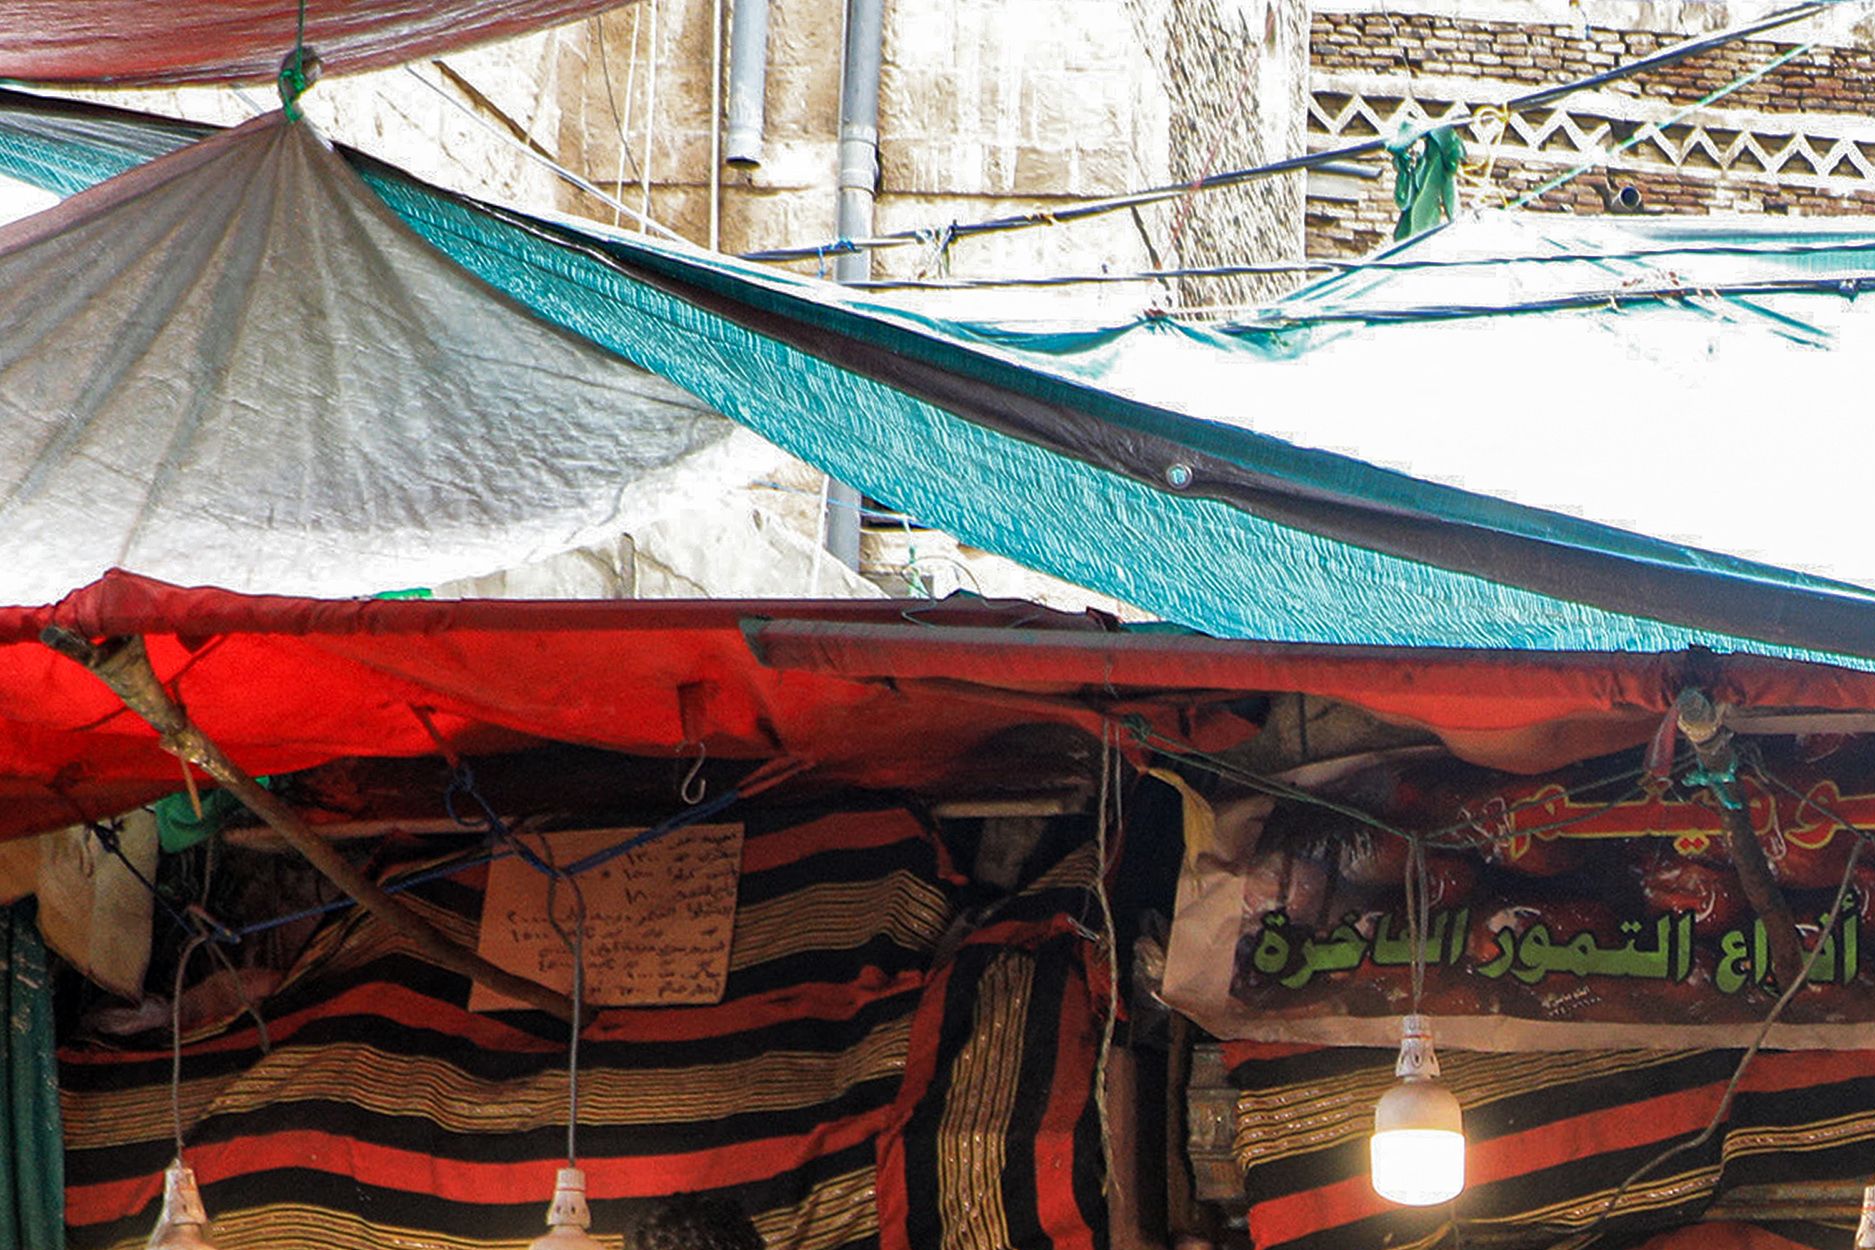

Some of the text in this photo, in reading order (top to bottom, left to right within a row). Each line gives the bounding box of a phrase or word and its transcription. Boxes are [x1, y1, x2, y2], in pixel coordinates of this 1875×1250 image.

[1254, 907, 1469, 990] الفاخرة
[1478, 912, 1696, 985] التمور
[1715, 893, 1859, 996] أناع
